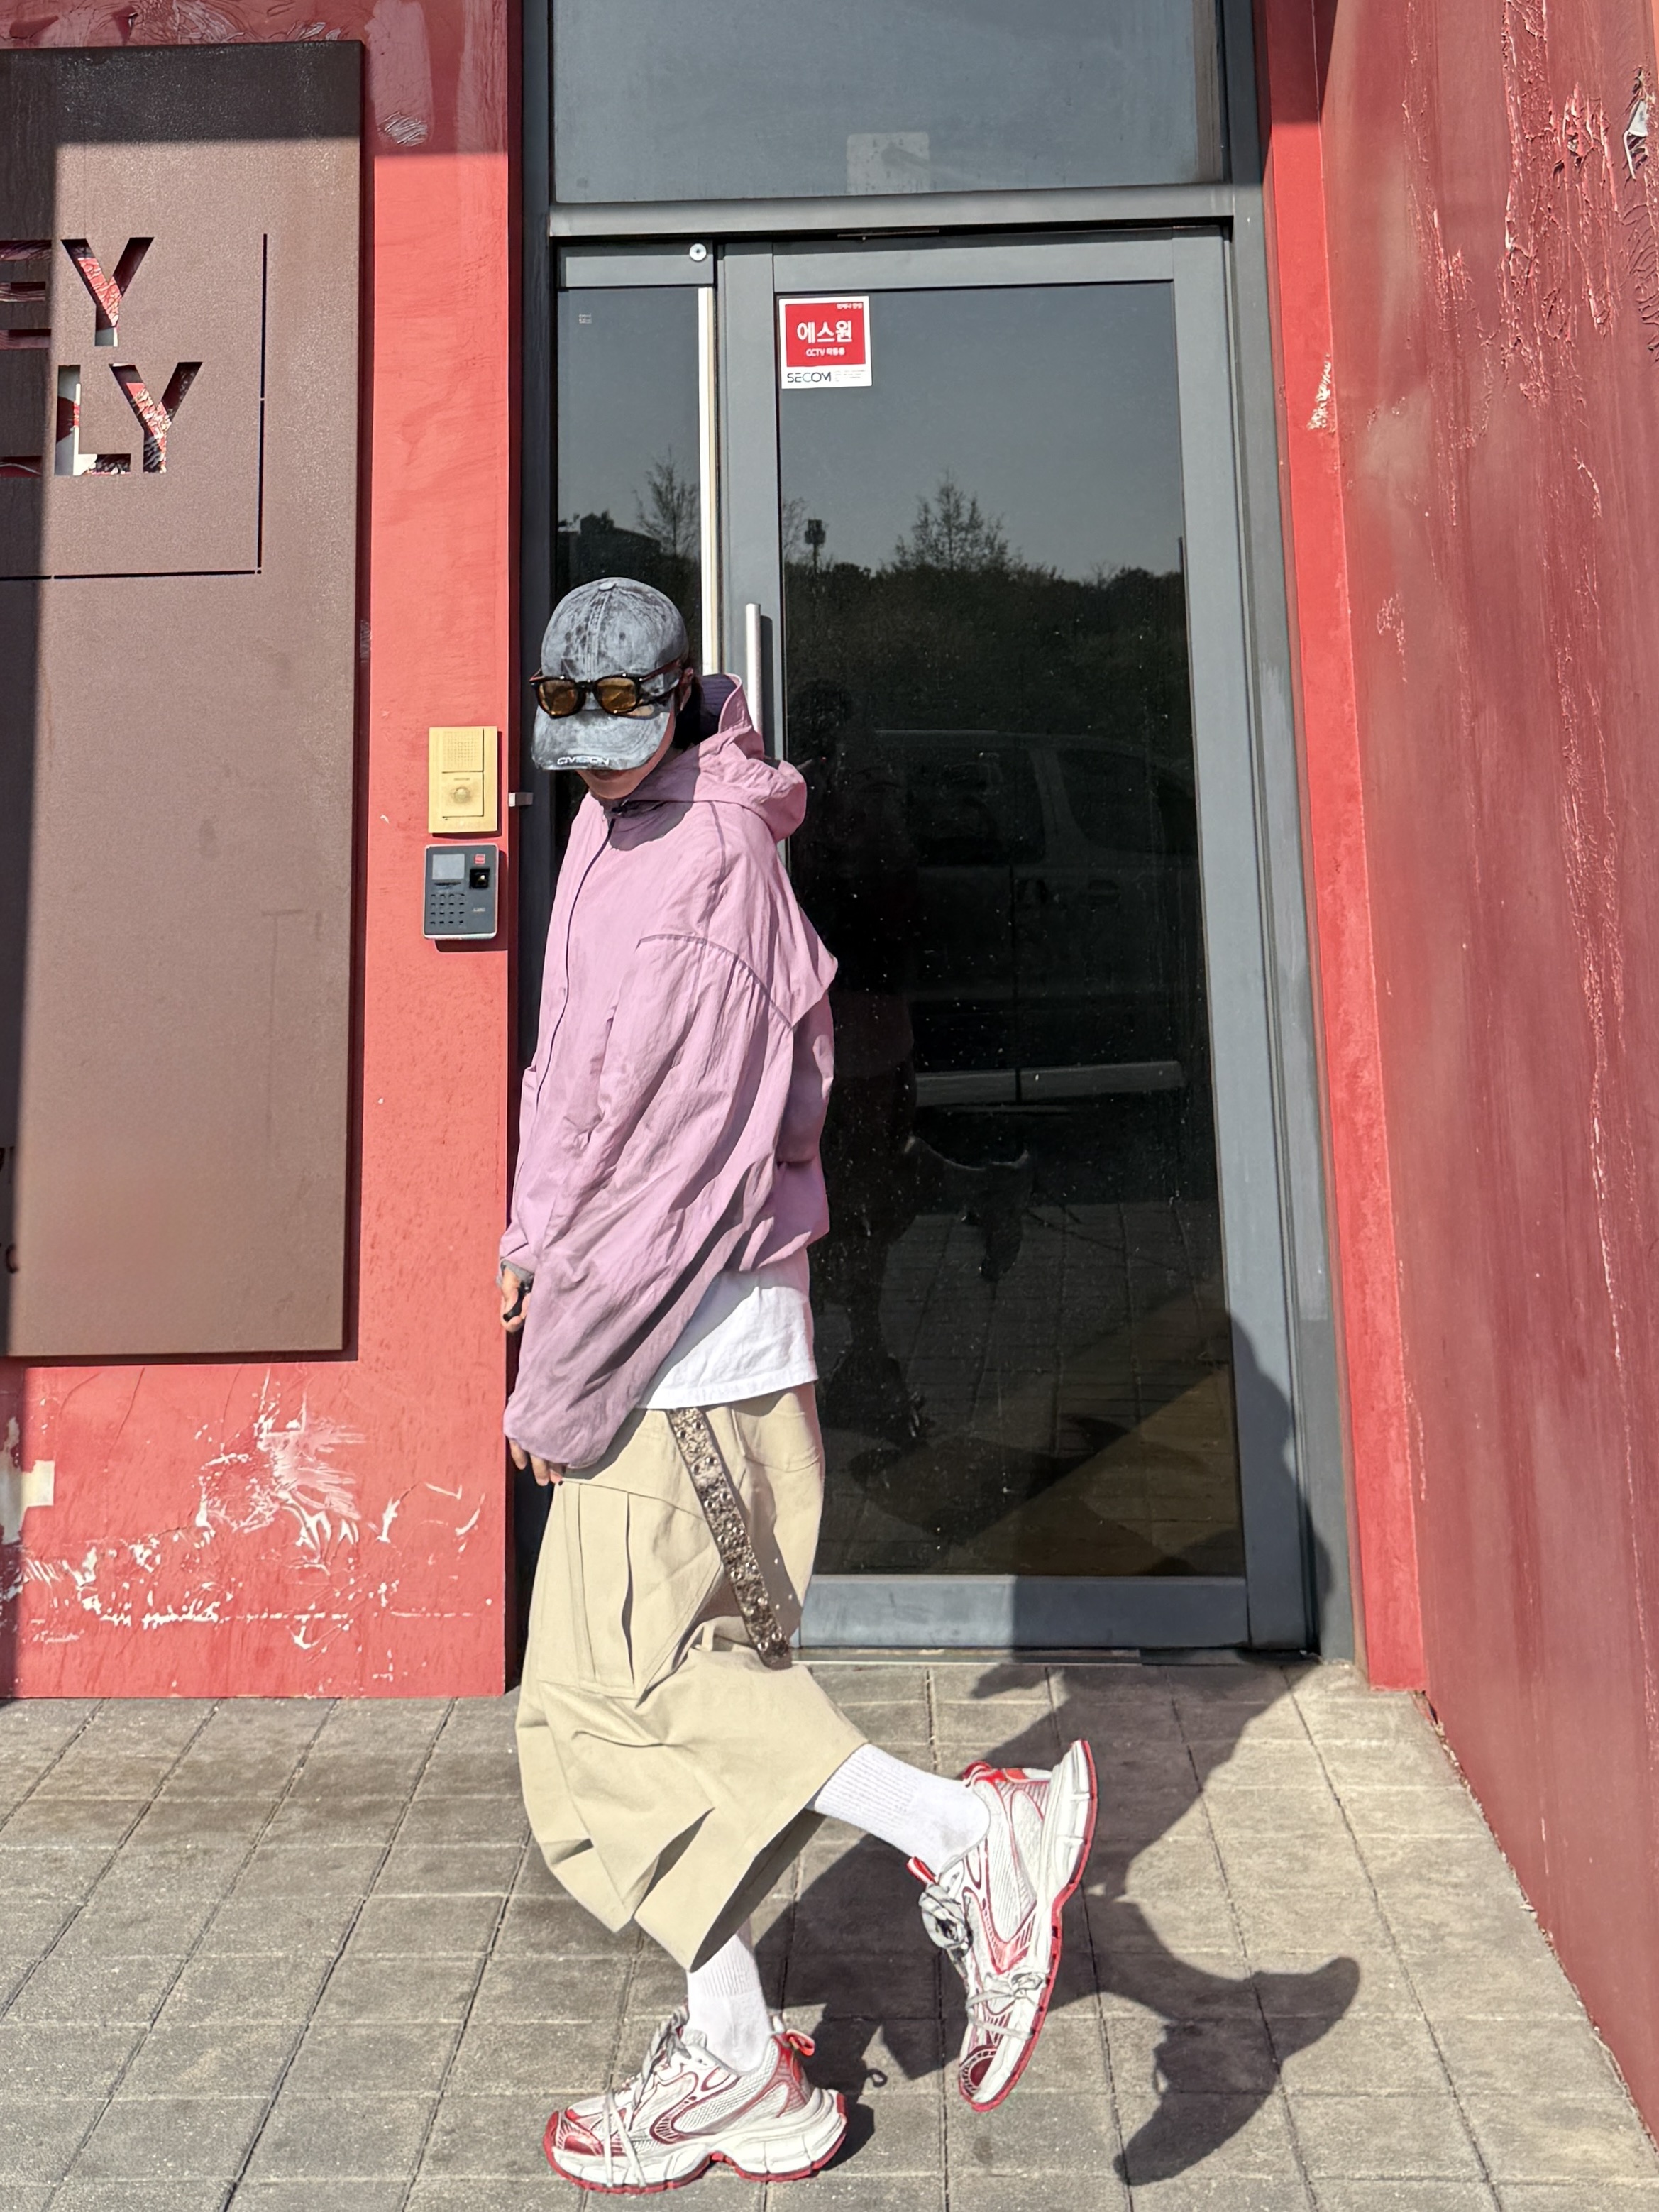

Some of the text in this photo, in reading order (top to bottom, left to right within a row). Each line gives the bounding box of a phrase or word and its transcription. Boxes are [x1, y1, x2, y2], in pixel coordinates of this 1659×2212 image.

[797, 320, 853, 343] 에스원
[806, 348, 825, 357] CCTV
[787, 371, 832, 383] SECOM
